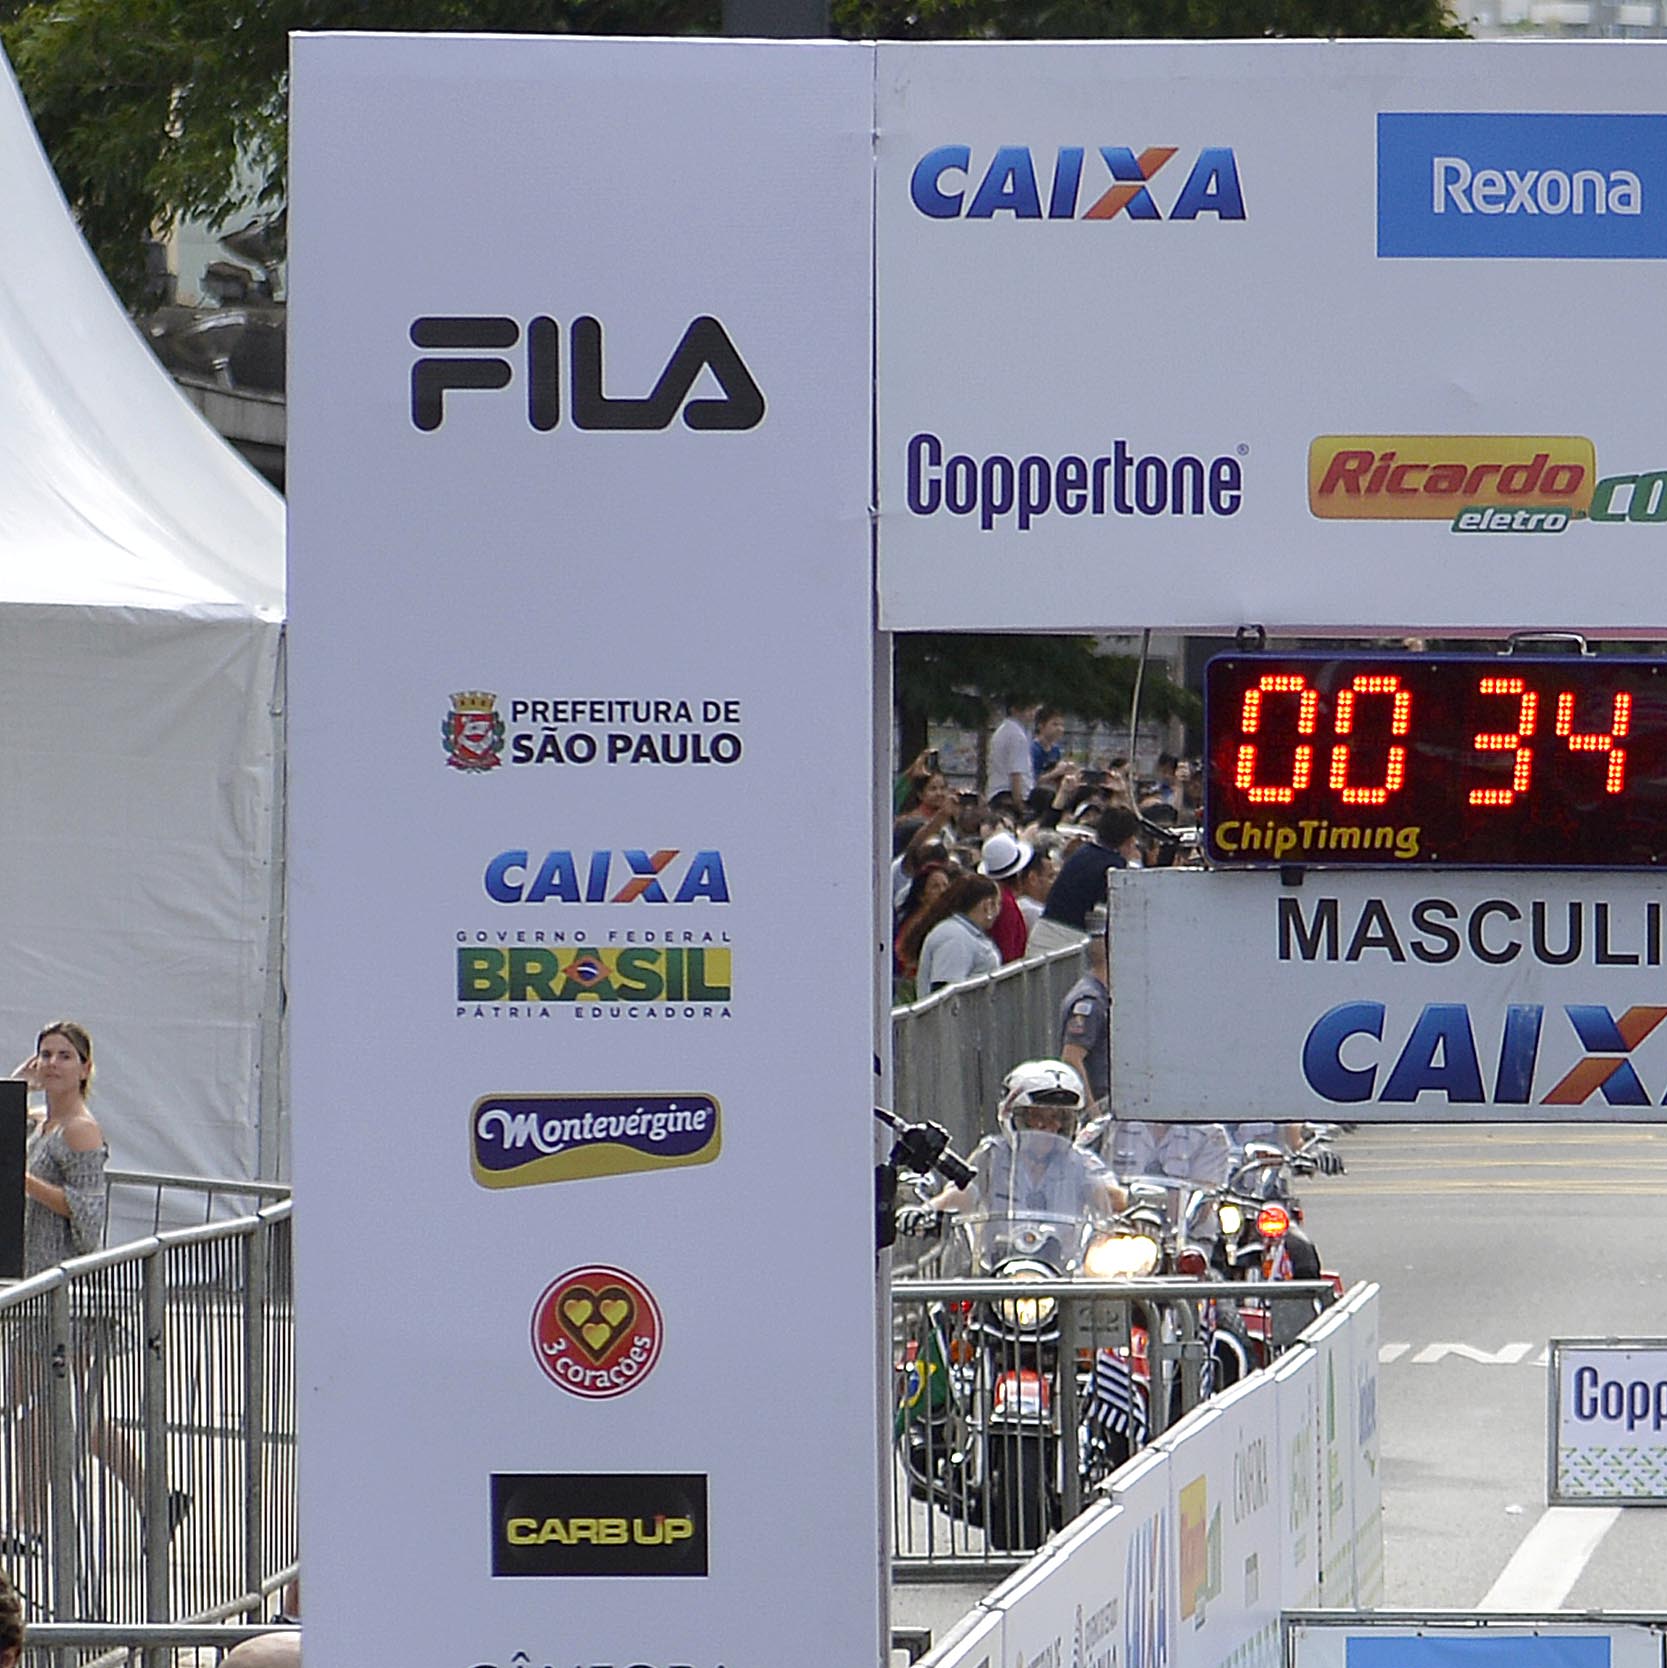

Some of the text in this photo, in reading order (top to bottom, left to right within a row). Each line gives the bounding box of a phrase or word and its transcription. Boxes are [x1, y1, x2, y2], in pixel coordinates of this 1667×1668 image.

[910, 146, 1247, 221] CAIXA
[1433, 157, 1641, 216] Rexona
[410, 315, 766, 433] FILA
[1317, 450, 1585, 496] Ricardo
[1458, 508, 1568, 532] eletro
[512, 701, 740, 722] PREFEITURA DE
[512, 727, 741, 764] SÃO PAULO
[484, 849, 730, 902] CAIXA
[457, 931, 730, 942] GOVERNO FEDERAL
[457, 947, 730, 1001] BRASIL
[457, 1004, 730, 1018] PÁTRIA EDUCADORA
[478, 1104, 706, 1152] Montevérgine
[543, 1334, 651, 1388] 3 corações
